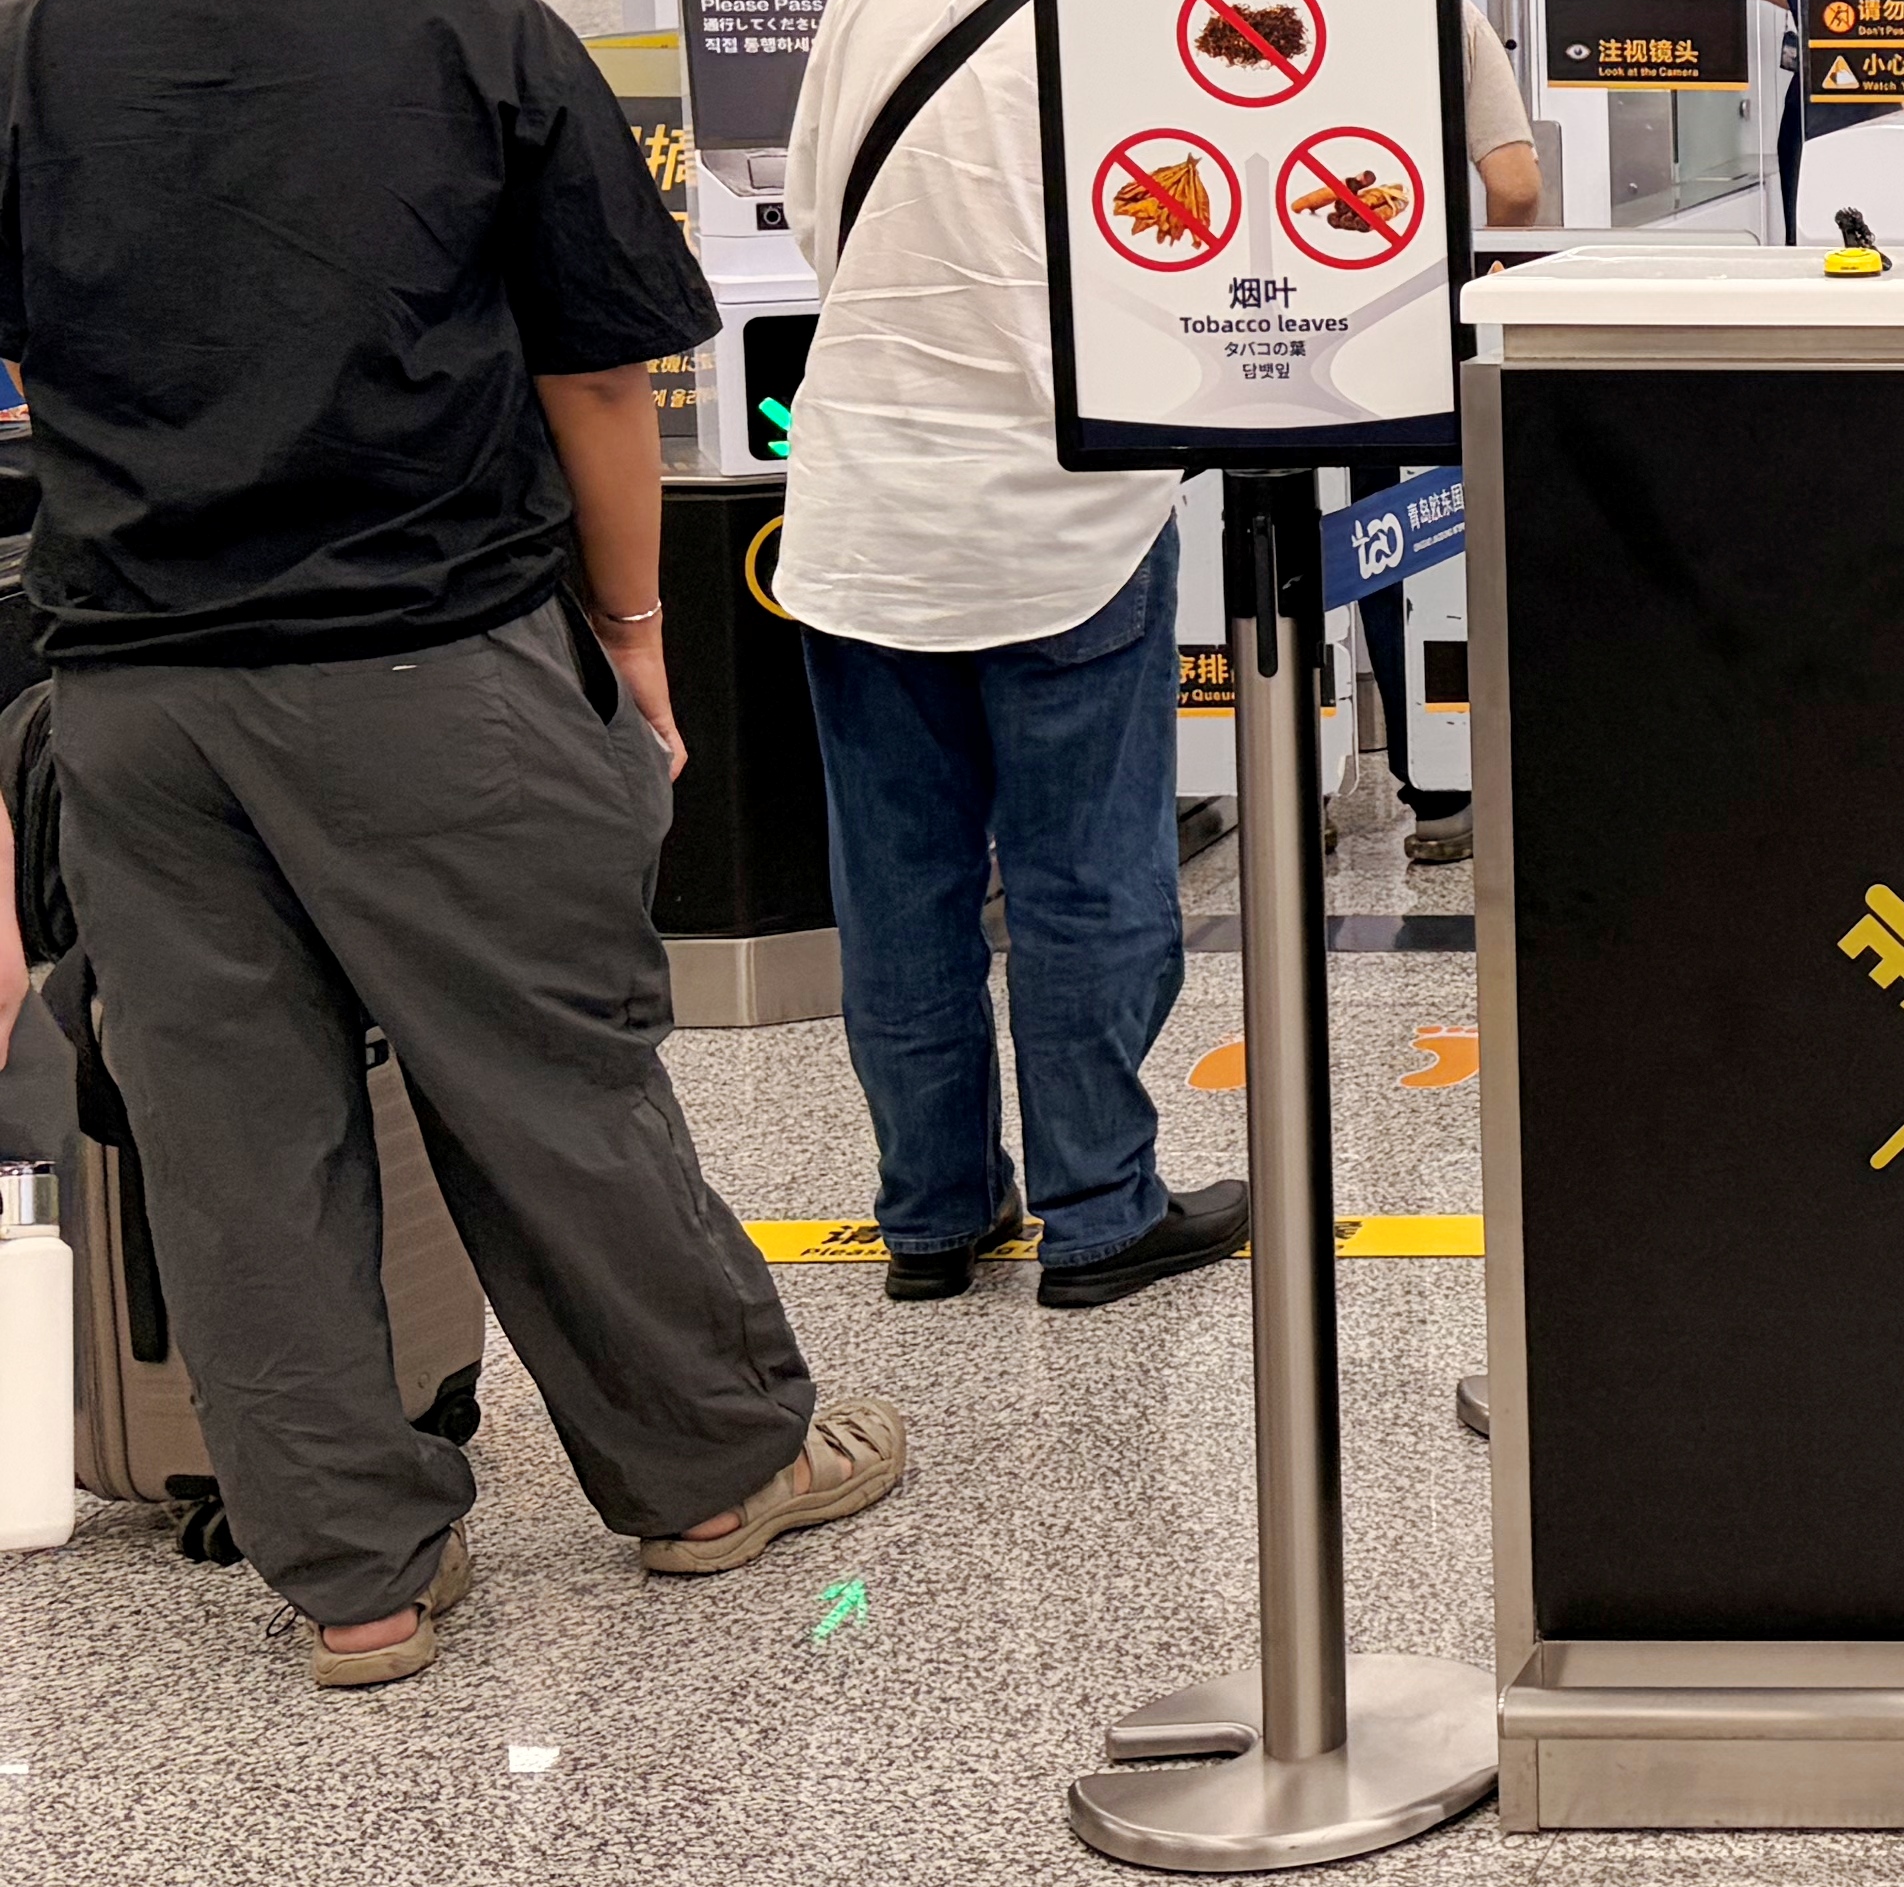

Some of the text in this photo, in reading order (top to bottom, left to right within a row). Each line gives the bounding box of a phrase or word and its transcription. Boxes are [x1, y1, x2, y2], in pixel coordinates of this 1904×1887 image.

[1858, 26, 1885, 37] Don't
[1598, 38, 1700, 63] 注视镜头
[1598, 66, 1700, 78] Look at the Camera
[1862, 81, 1897, 91] Watch
[1228, 276, 1297, 309] 烟叶
[1179, 315, 1349, 333] Tobacco leaves
[1224, 340, 1307, 358] タバコの葉
[1242, 362, 1291, 380] 담뱃잎
[1406, 482, 1465, 533] 青岛胶东国
[1178, 653, 1236, 685] 序排
